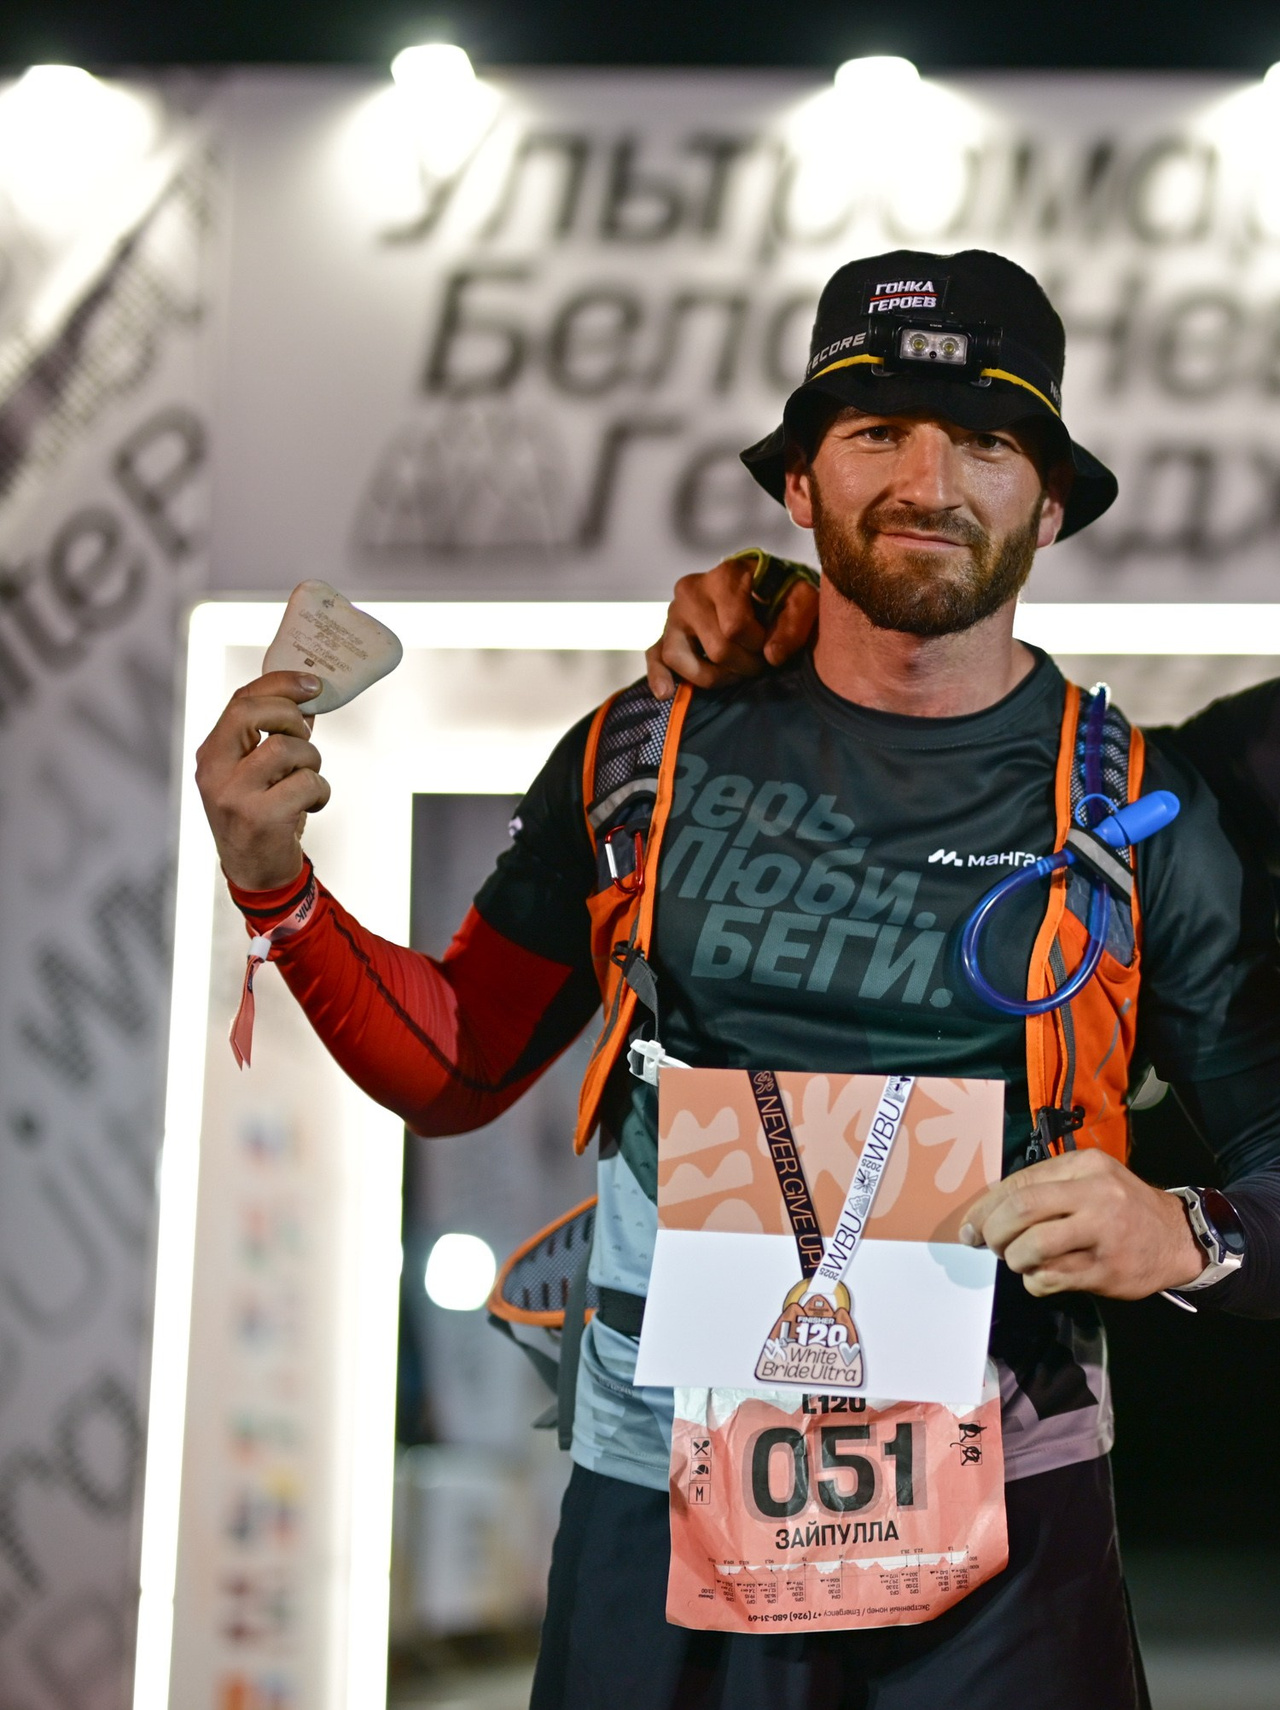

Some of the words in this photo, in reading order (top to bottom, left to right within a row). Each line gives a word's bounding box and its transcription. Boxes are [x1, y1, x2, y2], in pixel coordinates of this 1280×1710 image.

[875, 280, 935, 295] ГОНКА
[868, 296, 936, 313] ГЕРОЕВ
[660, 825, 936, 928] Люби.
[691, 903, 953, 1008] БЕГИ.
[864, 1098, 902, 1162] WBU
[860, 1158, 883, 1172] 2025
[757, 1096, 799, 1175] NEVER
[782, 1178, 816, 1230] GIVE
[799, 1234, 823, 1269] UP!
[823, 1210, 863, 1271] WBU
[818, 1267, 841, 1281] 2025
[797, 1316, 836, 1325] FINISHER
[790, 1347, 838, 1365] White
[761, 1361, 857, 1383] BrideUltra
[746, 1422, 922, 1520] 051
[775, 1520, 900, 1551] ЗАЙПУЛЛА
